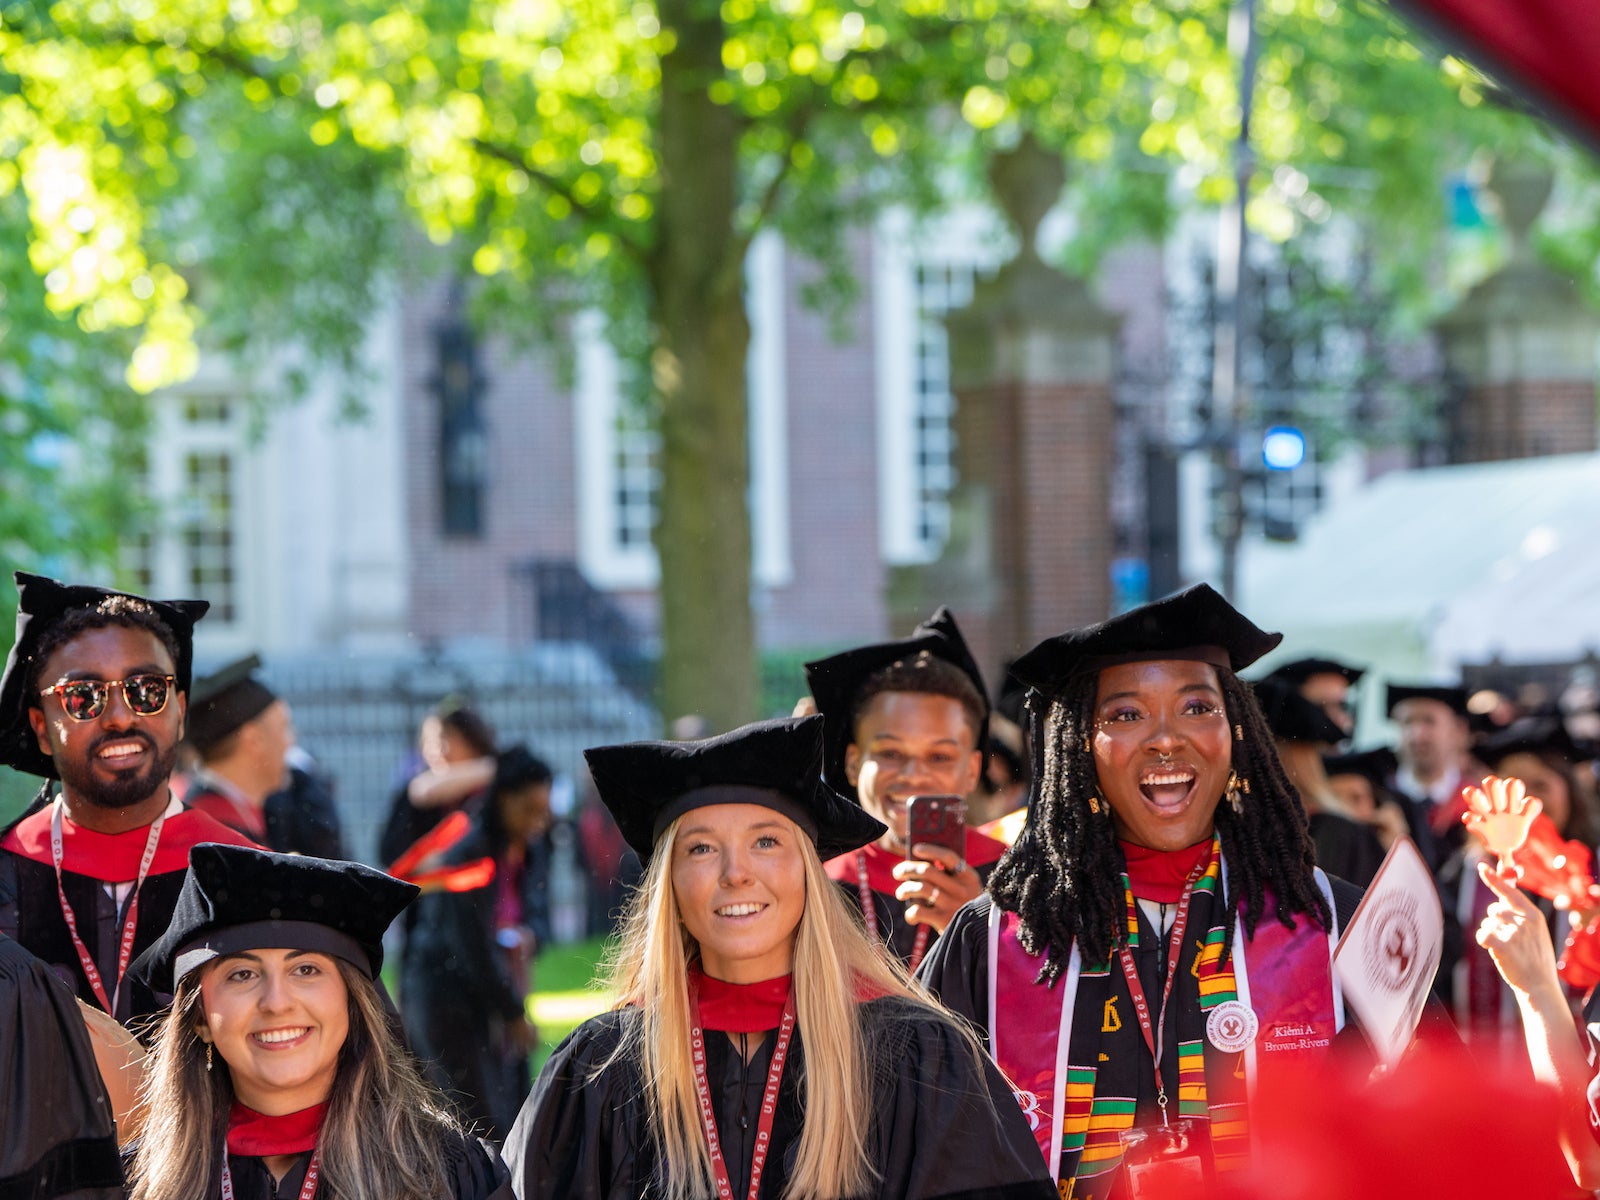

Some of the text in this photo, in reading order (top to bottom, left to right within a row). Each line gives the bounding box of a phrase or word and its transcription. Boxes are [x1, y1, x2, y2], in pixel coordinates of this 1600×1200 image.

[1172, 864, 1204, 945] UNIVERSITY
[82, 957, 101, 990] 2026
[1134, 994, 1151, 1029] 2026
[764, 1012, 793, 1115] UNIVERSITY
[1265, 1038, 1330, 1052] Brown-Rivers
[691, 1027, 721, 1161] COMMENCEMENT
